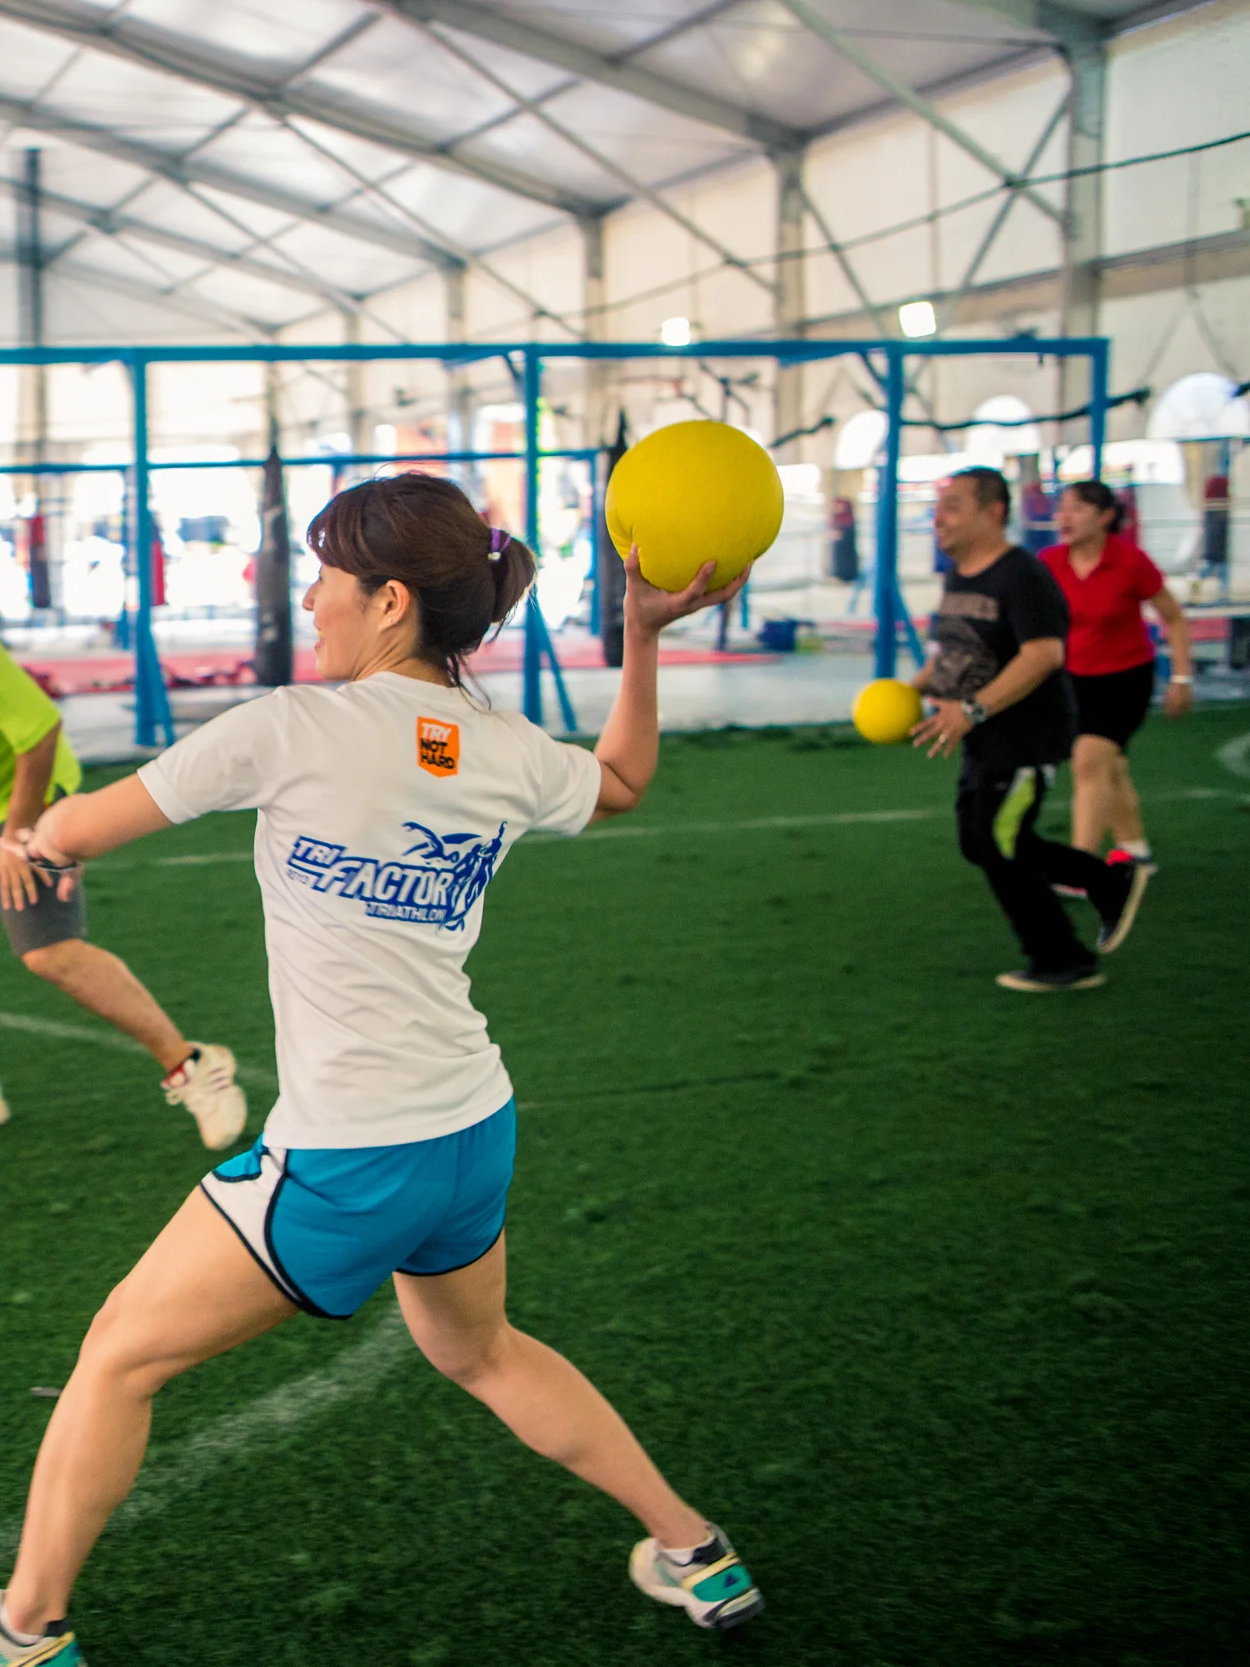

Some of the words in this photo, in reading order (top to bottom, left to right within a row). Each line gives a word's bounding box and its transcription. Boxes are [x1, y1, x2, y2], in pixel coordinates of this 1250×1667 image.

[421, 722, 452, 743] TRY
[419, 738, 447, 755] NOT
[419, 750, 455, 770] HARD
[293, 838, 340, 863] TRI
[306, 861, 454, 907] FACTOR
[365, 902, 448, 921] TRIATHLON
